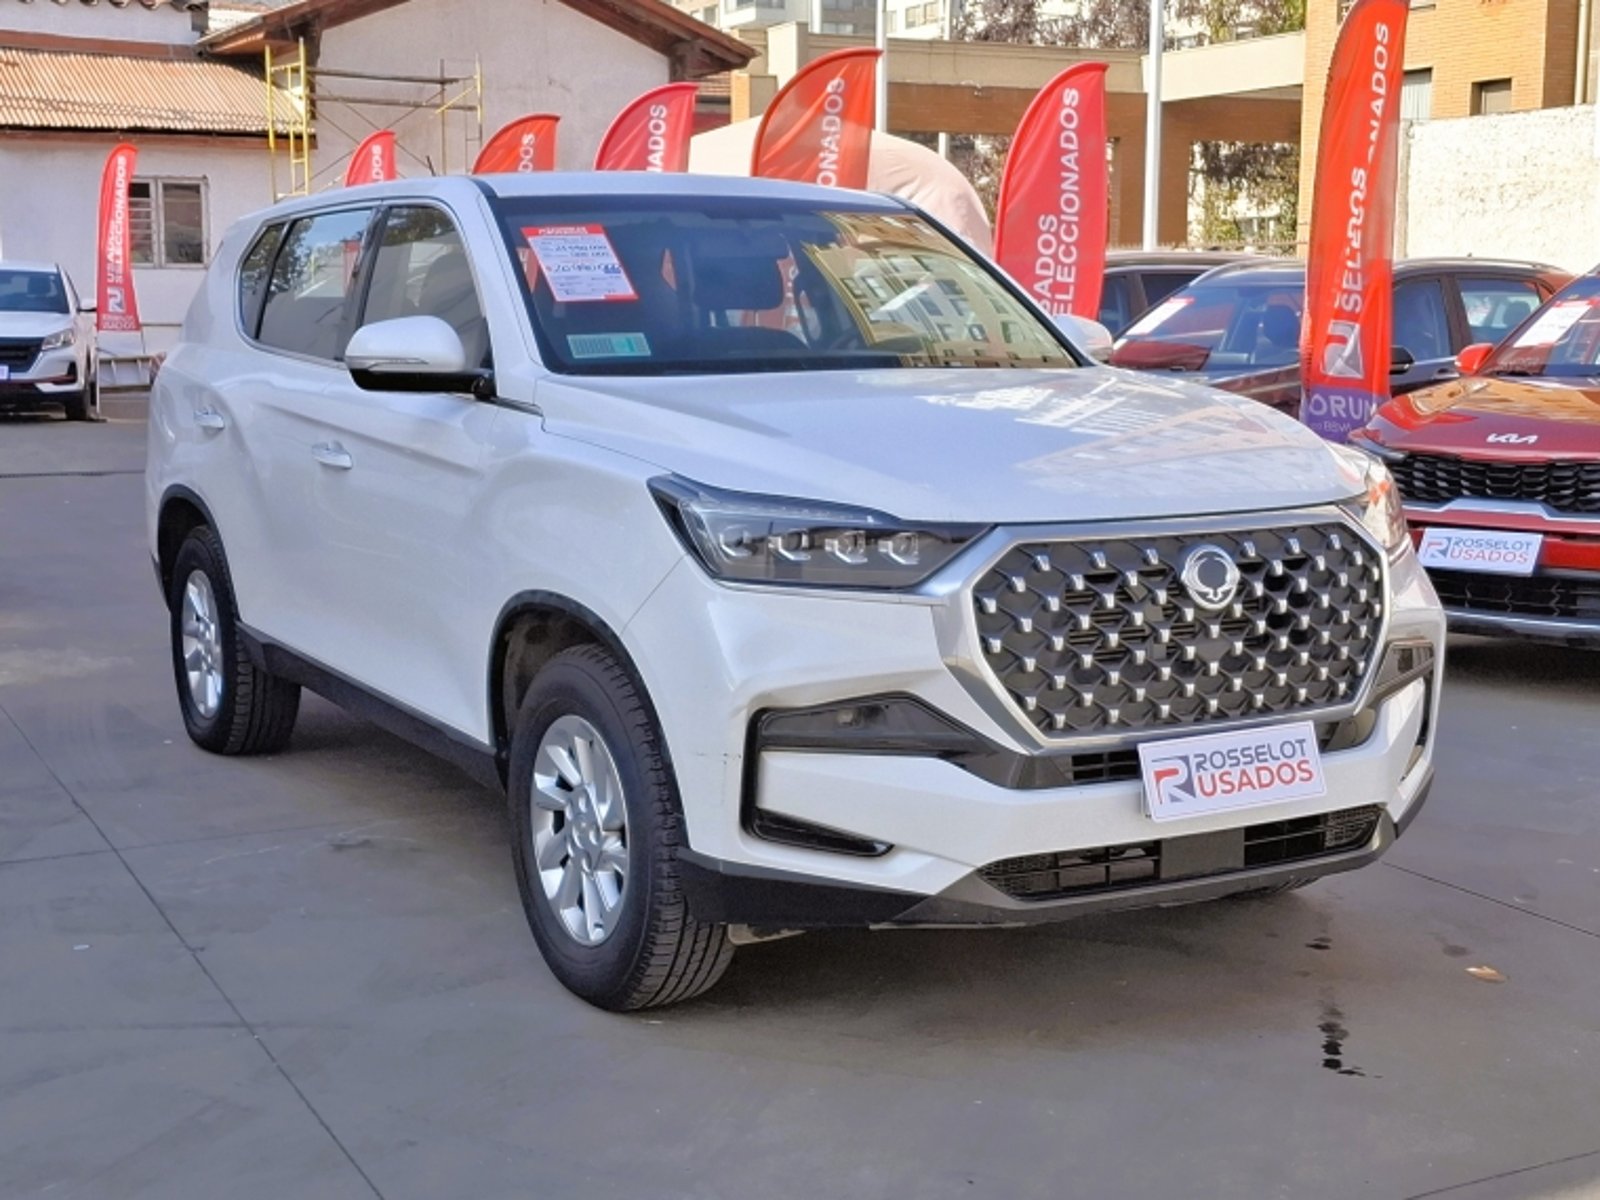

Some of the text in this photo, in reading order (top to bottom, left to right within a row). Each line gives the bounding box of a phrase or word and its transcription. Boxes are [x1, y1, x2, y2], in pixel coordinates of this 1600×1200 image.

[646, 104, 667, 172] ADOS
[1486, 433, 1539, 444] KIA
[1452, 537, 1533, 551] ROSSELOT
[1450, 549, 1529, 564] USADOS
[1193, 738, 1307, 772] ROSSELOT
[1198, 760, 1314, 797] USADOS
